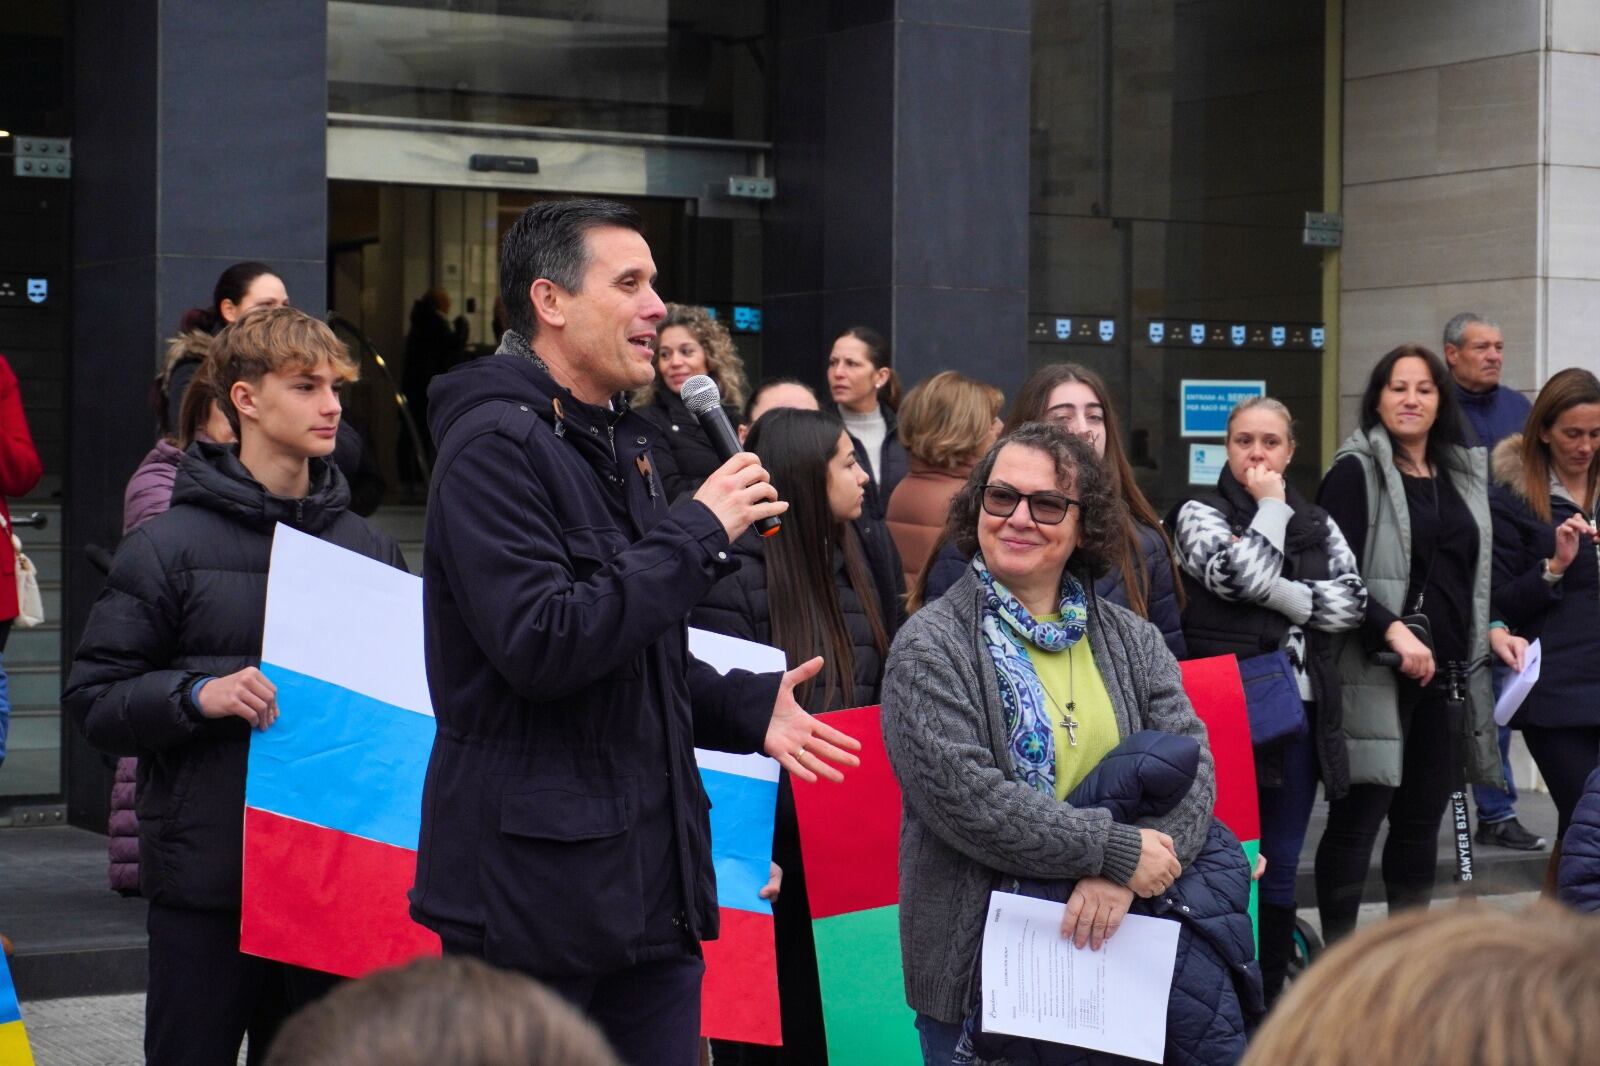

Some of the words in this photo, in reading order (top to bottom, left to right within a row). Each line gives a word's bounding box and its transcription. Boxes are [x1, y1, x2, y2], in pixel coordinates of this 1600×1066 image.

[1186, 393, 1216, 401] ENTRADA
[1217, 393, 1225, 401] AL
[1457, 833, 1473, 881] SAWYER
